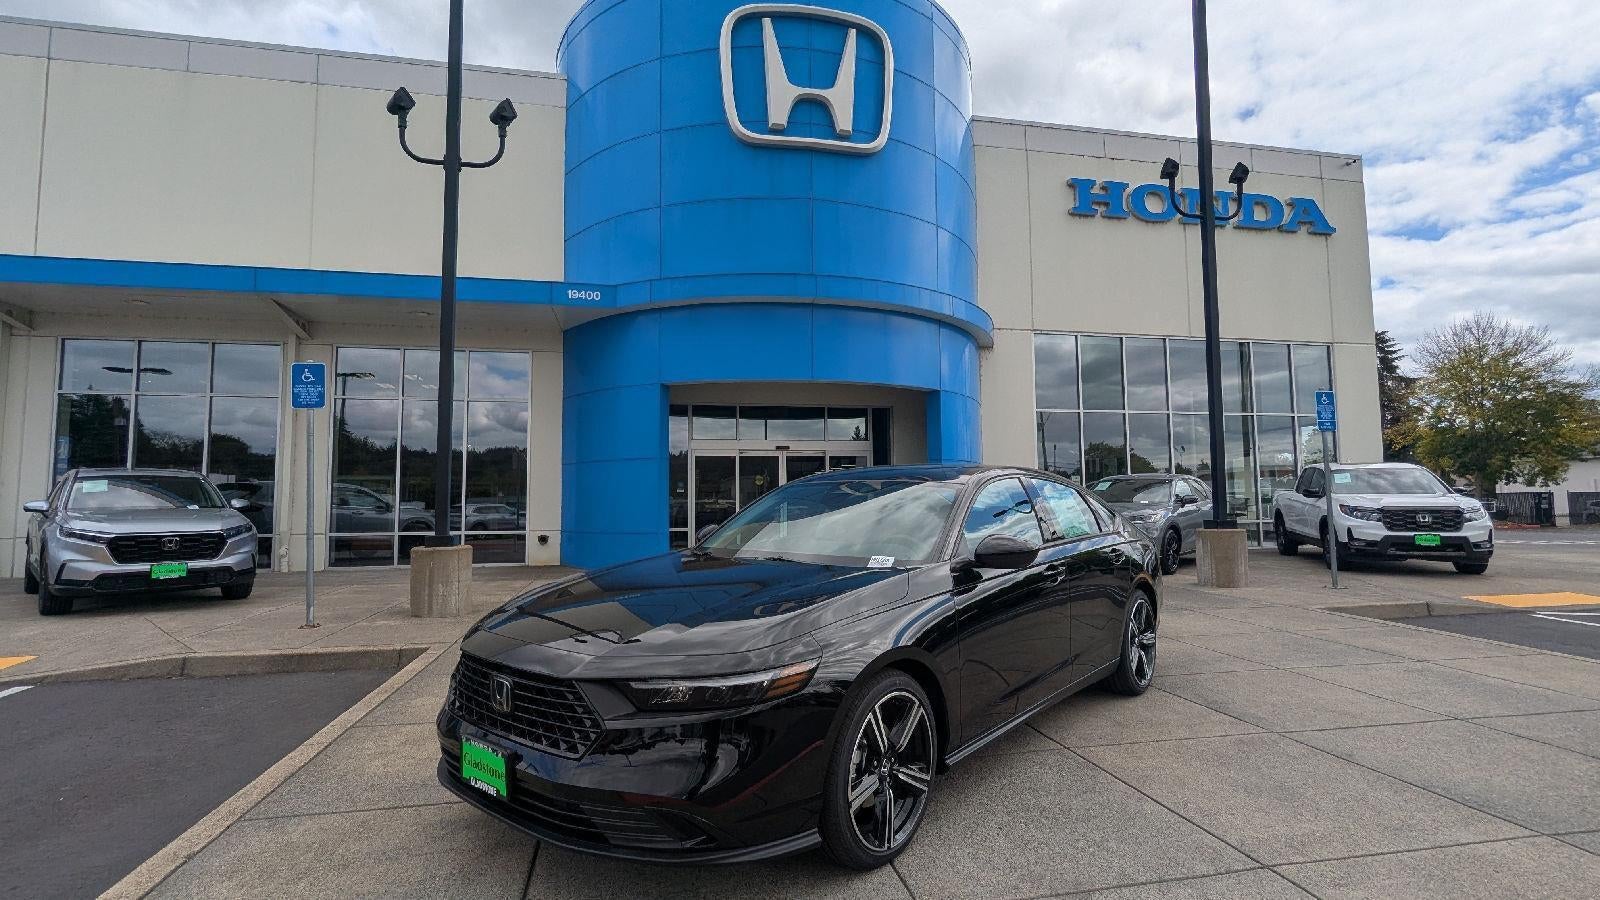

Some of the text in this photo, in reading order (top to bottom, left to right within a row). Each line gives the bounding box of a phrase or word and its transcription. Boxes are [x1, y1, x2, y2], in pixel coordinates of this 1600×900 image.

[1067, 178, 1336, 235] HONDA
[567, 289, 601, 301] 19400
[464, 752, 505, 782] Gladstone
